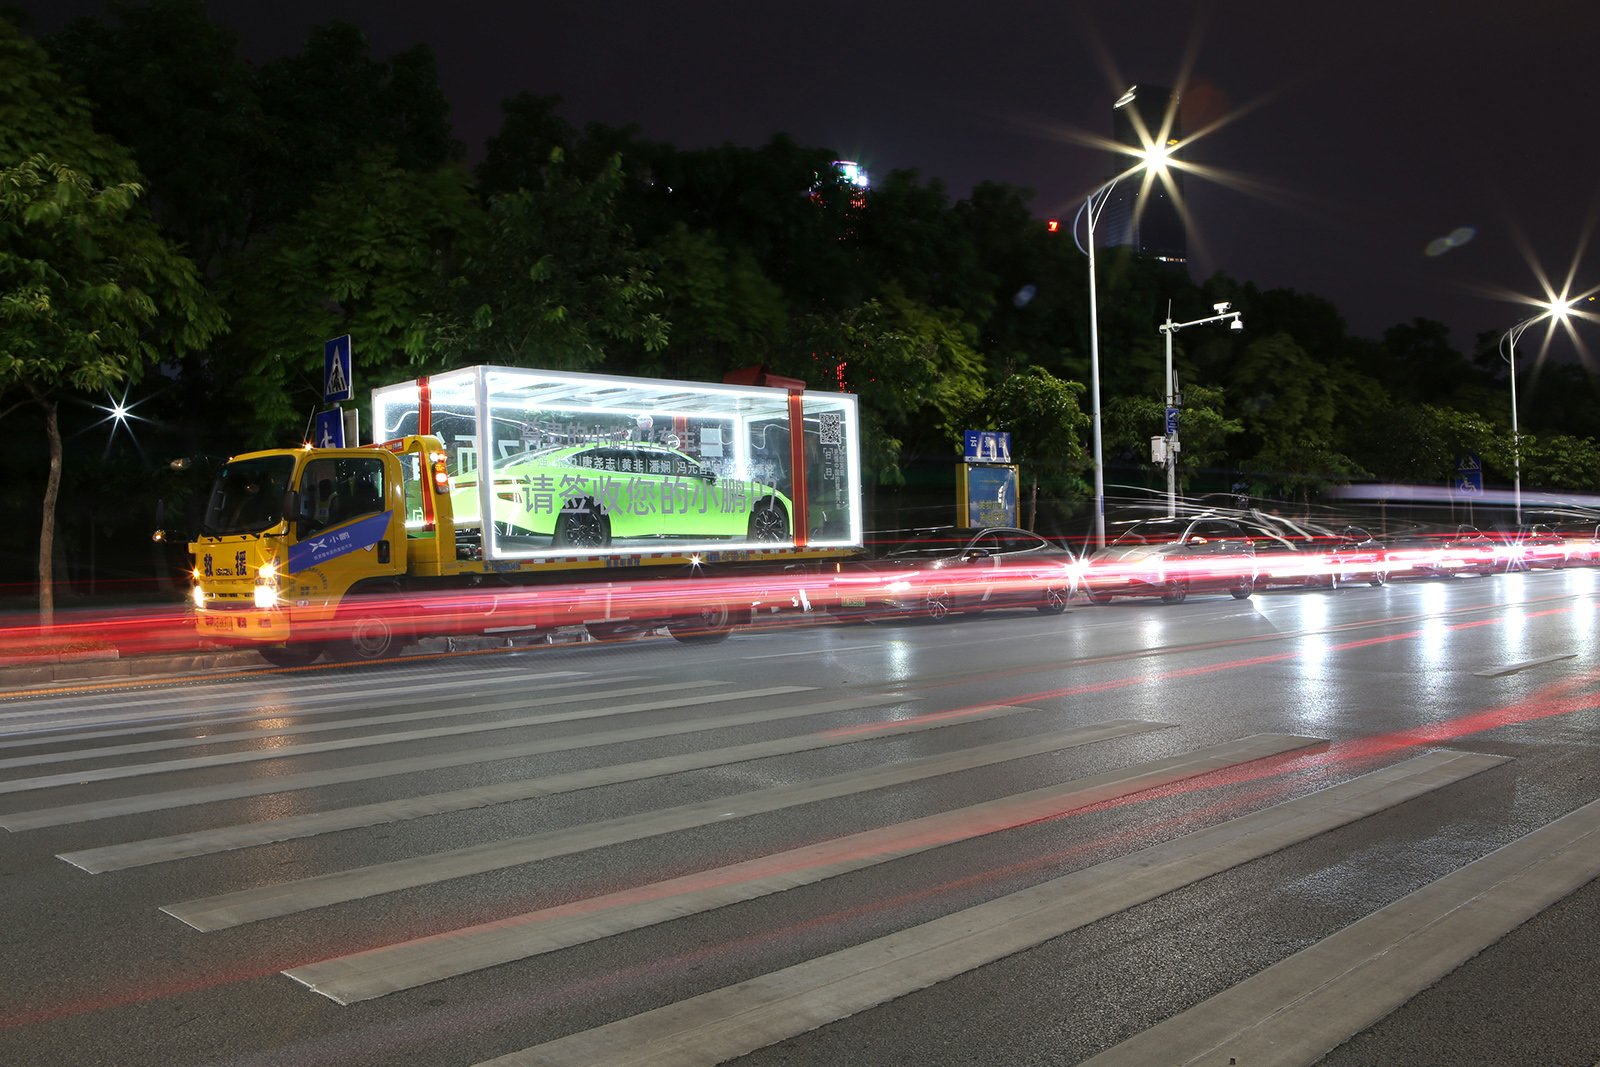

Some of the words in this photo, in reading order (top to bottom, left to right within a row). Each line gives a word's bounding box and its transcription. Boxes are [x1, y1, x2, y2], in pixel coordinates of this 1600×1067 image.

[522, 474, 777, 515] 请签收您的小鹏P7
